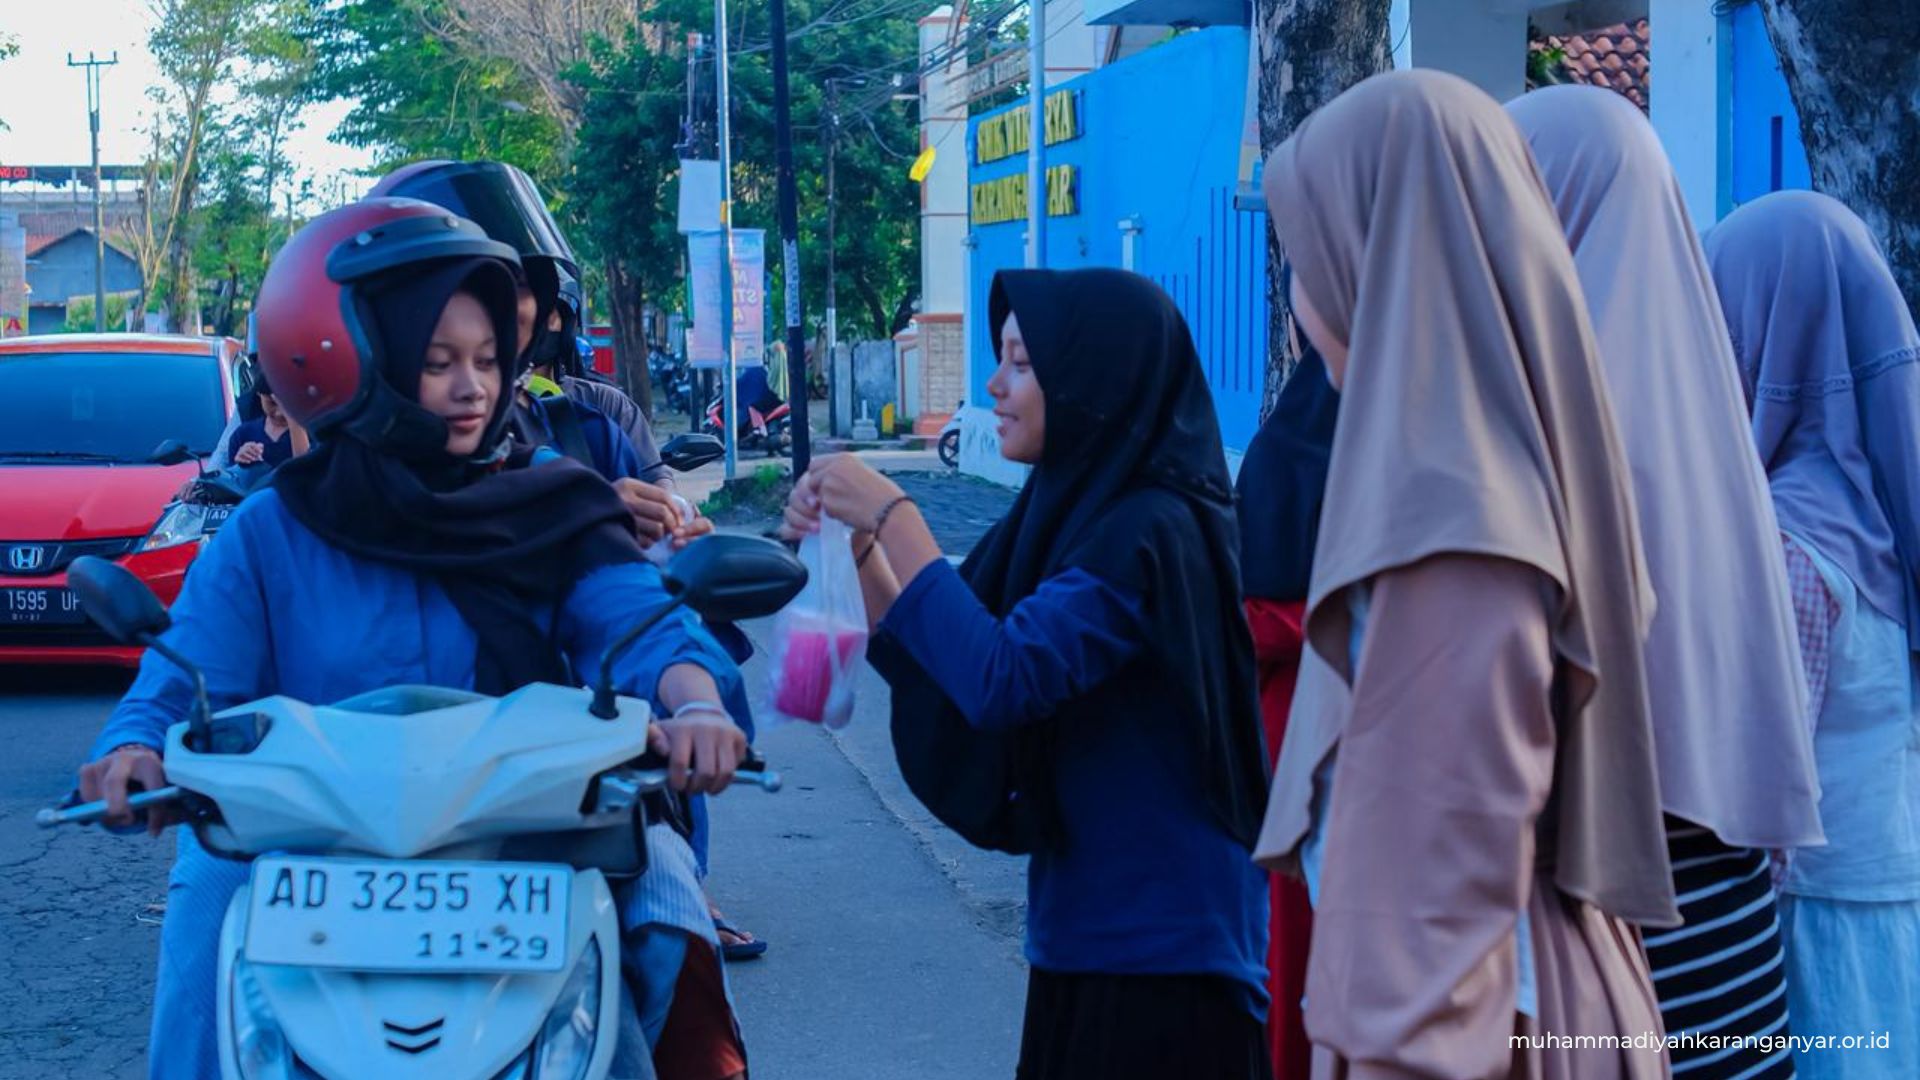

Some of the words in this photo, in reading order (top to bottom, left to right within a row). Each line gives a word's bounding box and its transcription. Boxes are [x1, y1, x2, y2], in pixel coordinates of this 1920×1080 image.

[1005, 89, 1077, 155] WIKRYA
[8, 590, 48, 611] 1595
[266, 867, 328, 909] AD
[351, 871, 469, 911] 3255
[496, 874, 551, 914] XH
